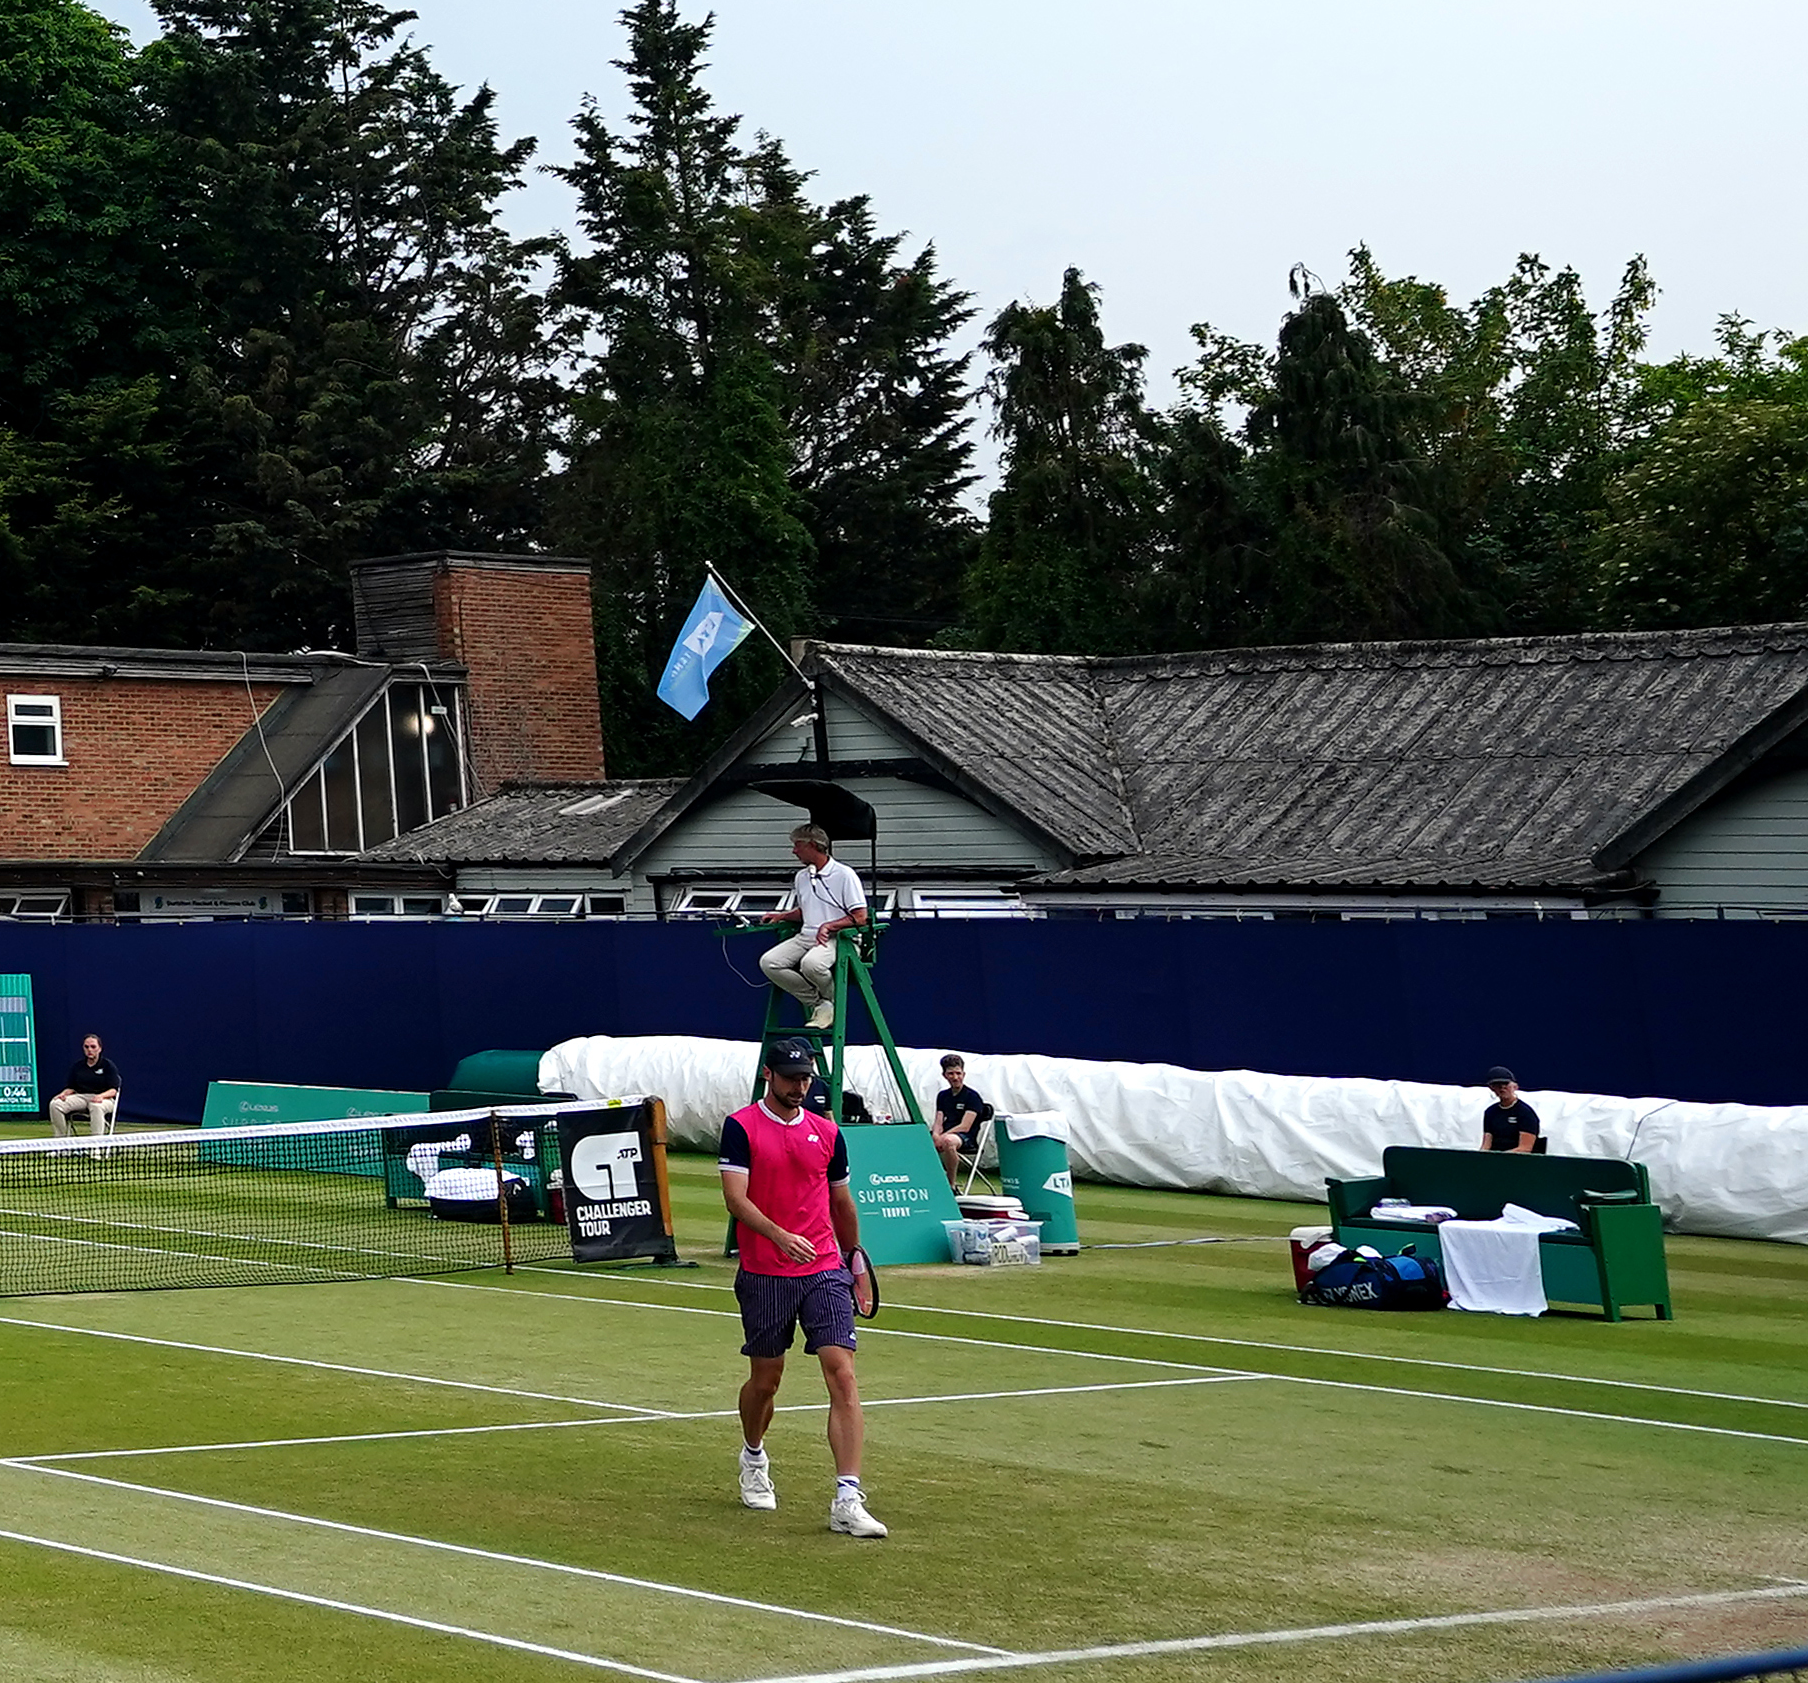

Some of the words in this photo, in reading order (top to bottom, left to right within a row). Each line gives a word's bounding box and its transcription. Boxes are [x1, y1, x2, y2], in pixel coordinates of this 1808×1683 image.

[617, 1147, 638, 1159] ATP
[858, 1188, 929, 1204] SURBITON
[576, 1200, 652, 1221] CHALLENGER
[578, 1220, 611, 1237] TOUR
